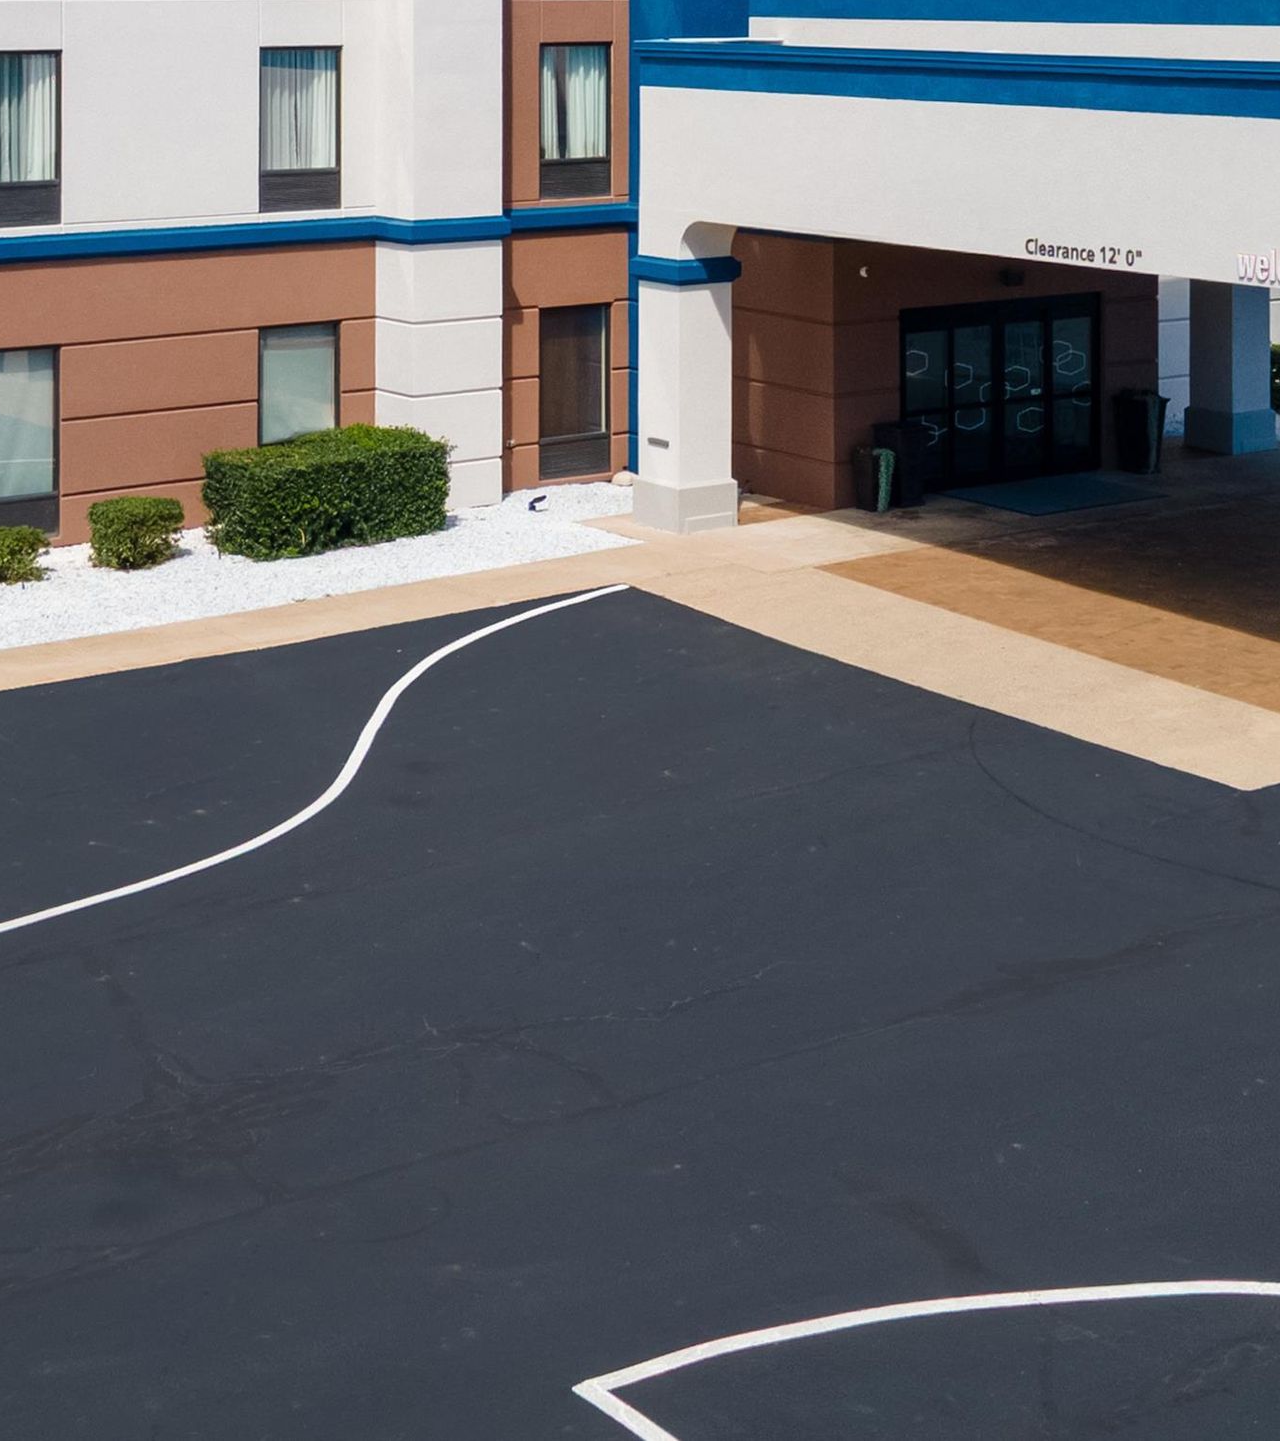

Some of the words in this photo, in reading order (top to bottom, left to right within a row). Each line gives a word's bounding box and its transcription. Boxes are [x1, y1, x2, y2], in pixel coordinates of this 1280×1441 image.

[1025, 238, 1095, 263] Clearance
[1100, 246, 1121, 265] 12'
[1125, 249, 1143, 267] 0"
